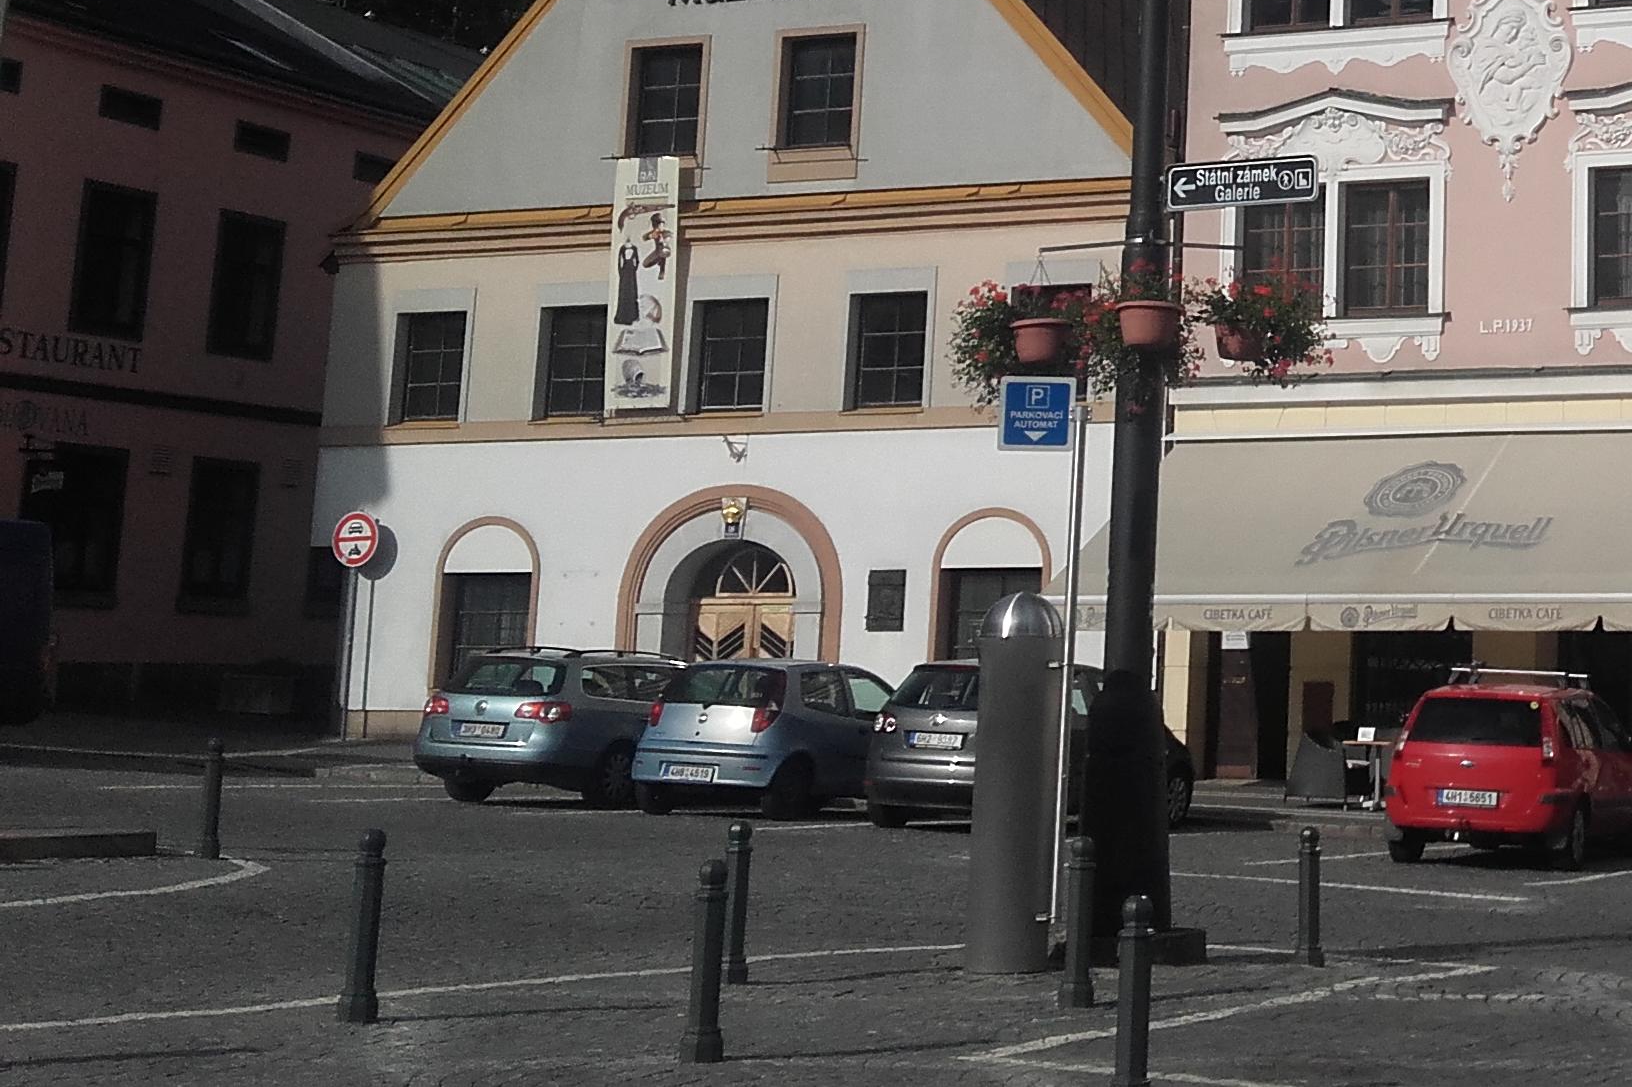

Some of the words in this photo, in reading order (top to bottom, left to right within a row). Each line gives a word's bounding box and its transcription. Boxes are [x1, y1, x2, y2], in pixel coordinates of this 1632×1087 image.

[1195, 167, 1233, 187] Státní
[1236, 165, 1278, 183] zámek
[626, 182, 669, 195] MUZEUM
[1215, 184, 1260, 201] Galerie
[1031, 388, 1044, 405] P
[1010, 410, 1063, 419] PARKOVACÍ
[1013, 421, 1058, 429] AUTOMAT
[1295, 520, 1434, 566] Pilsner
[1432, 512, 1554, 549] Urquell
[1203, 609, 1245, 620] CIBETKA
[1248, 606, 1272, 620] CAFÉ
[1488, 608, 1533, 620] CIBETKA
